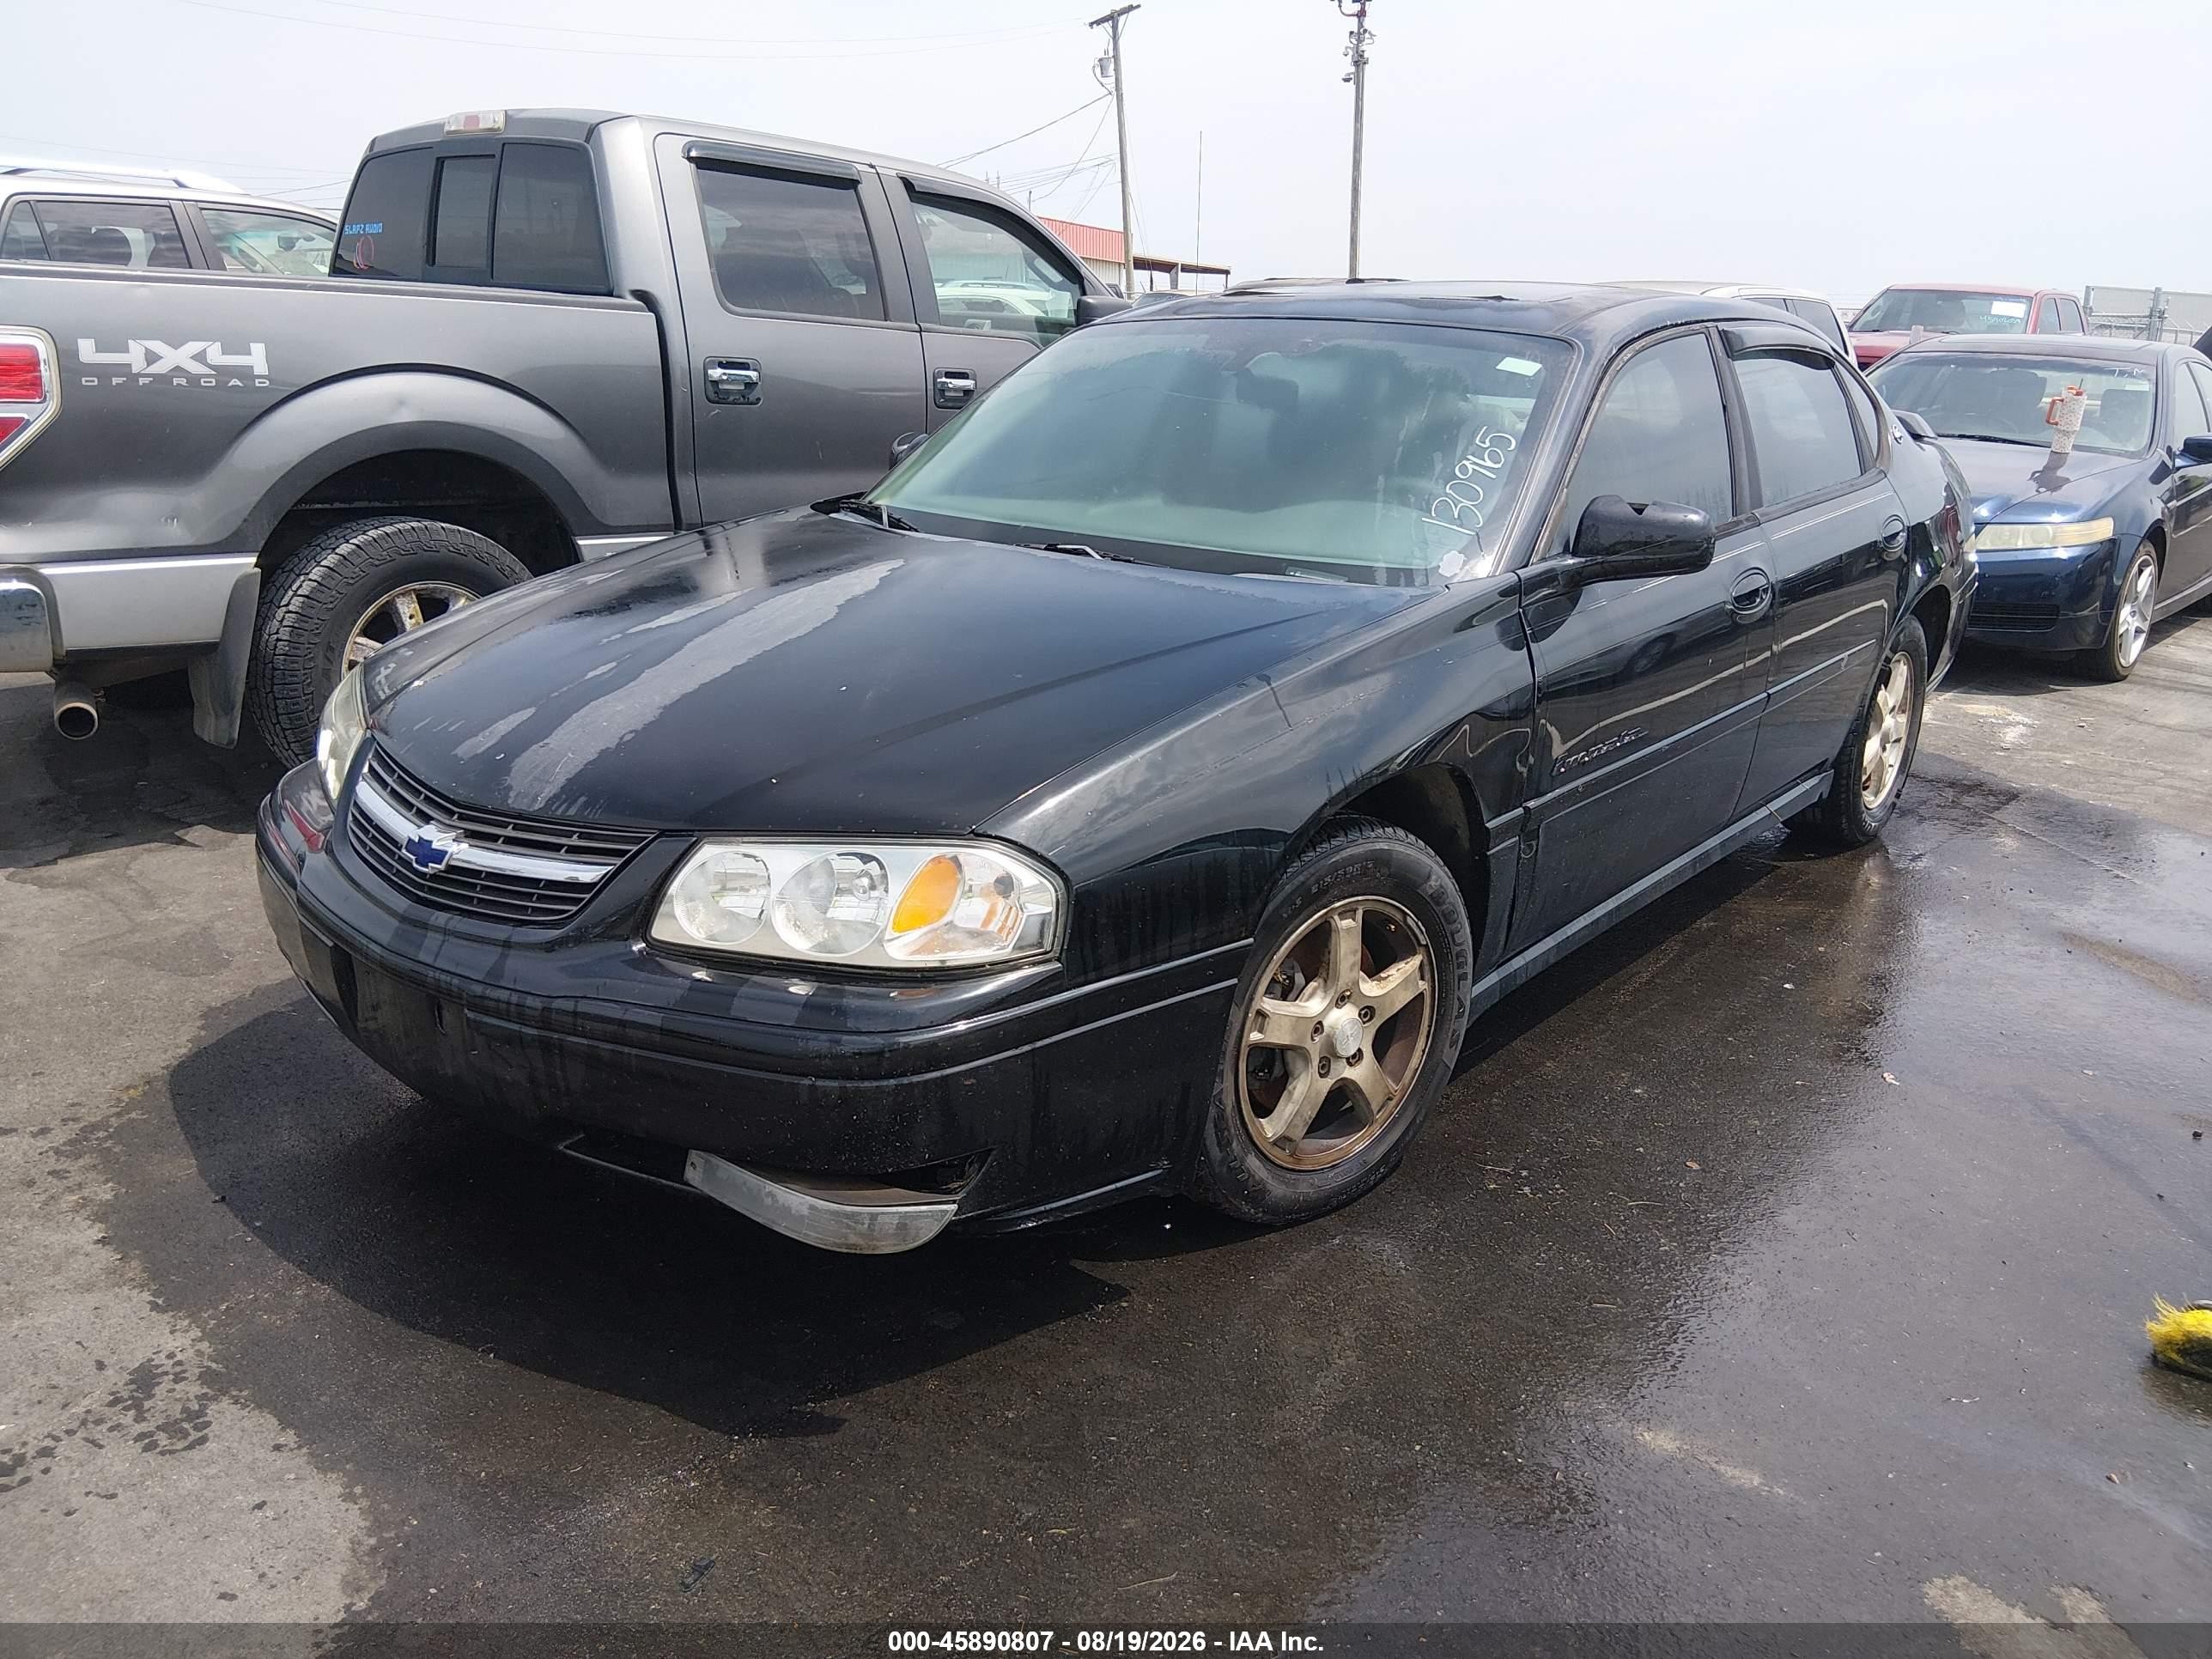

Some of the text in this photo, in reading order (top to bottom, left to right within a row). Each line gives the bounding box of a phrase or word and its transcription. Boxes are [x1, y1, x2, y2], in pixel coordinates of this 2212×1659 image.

[76, 338, 269, 375] 4X4
[81, 377, 270, 386] OFF ROAD
[1421, 425, 1517, 536] 130965
[1428, 884, 1469, 1050] DOUGLAS
